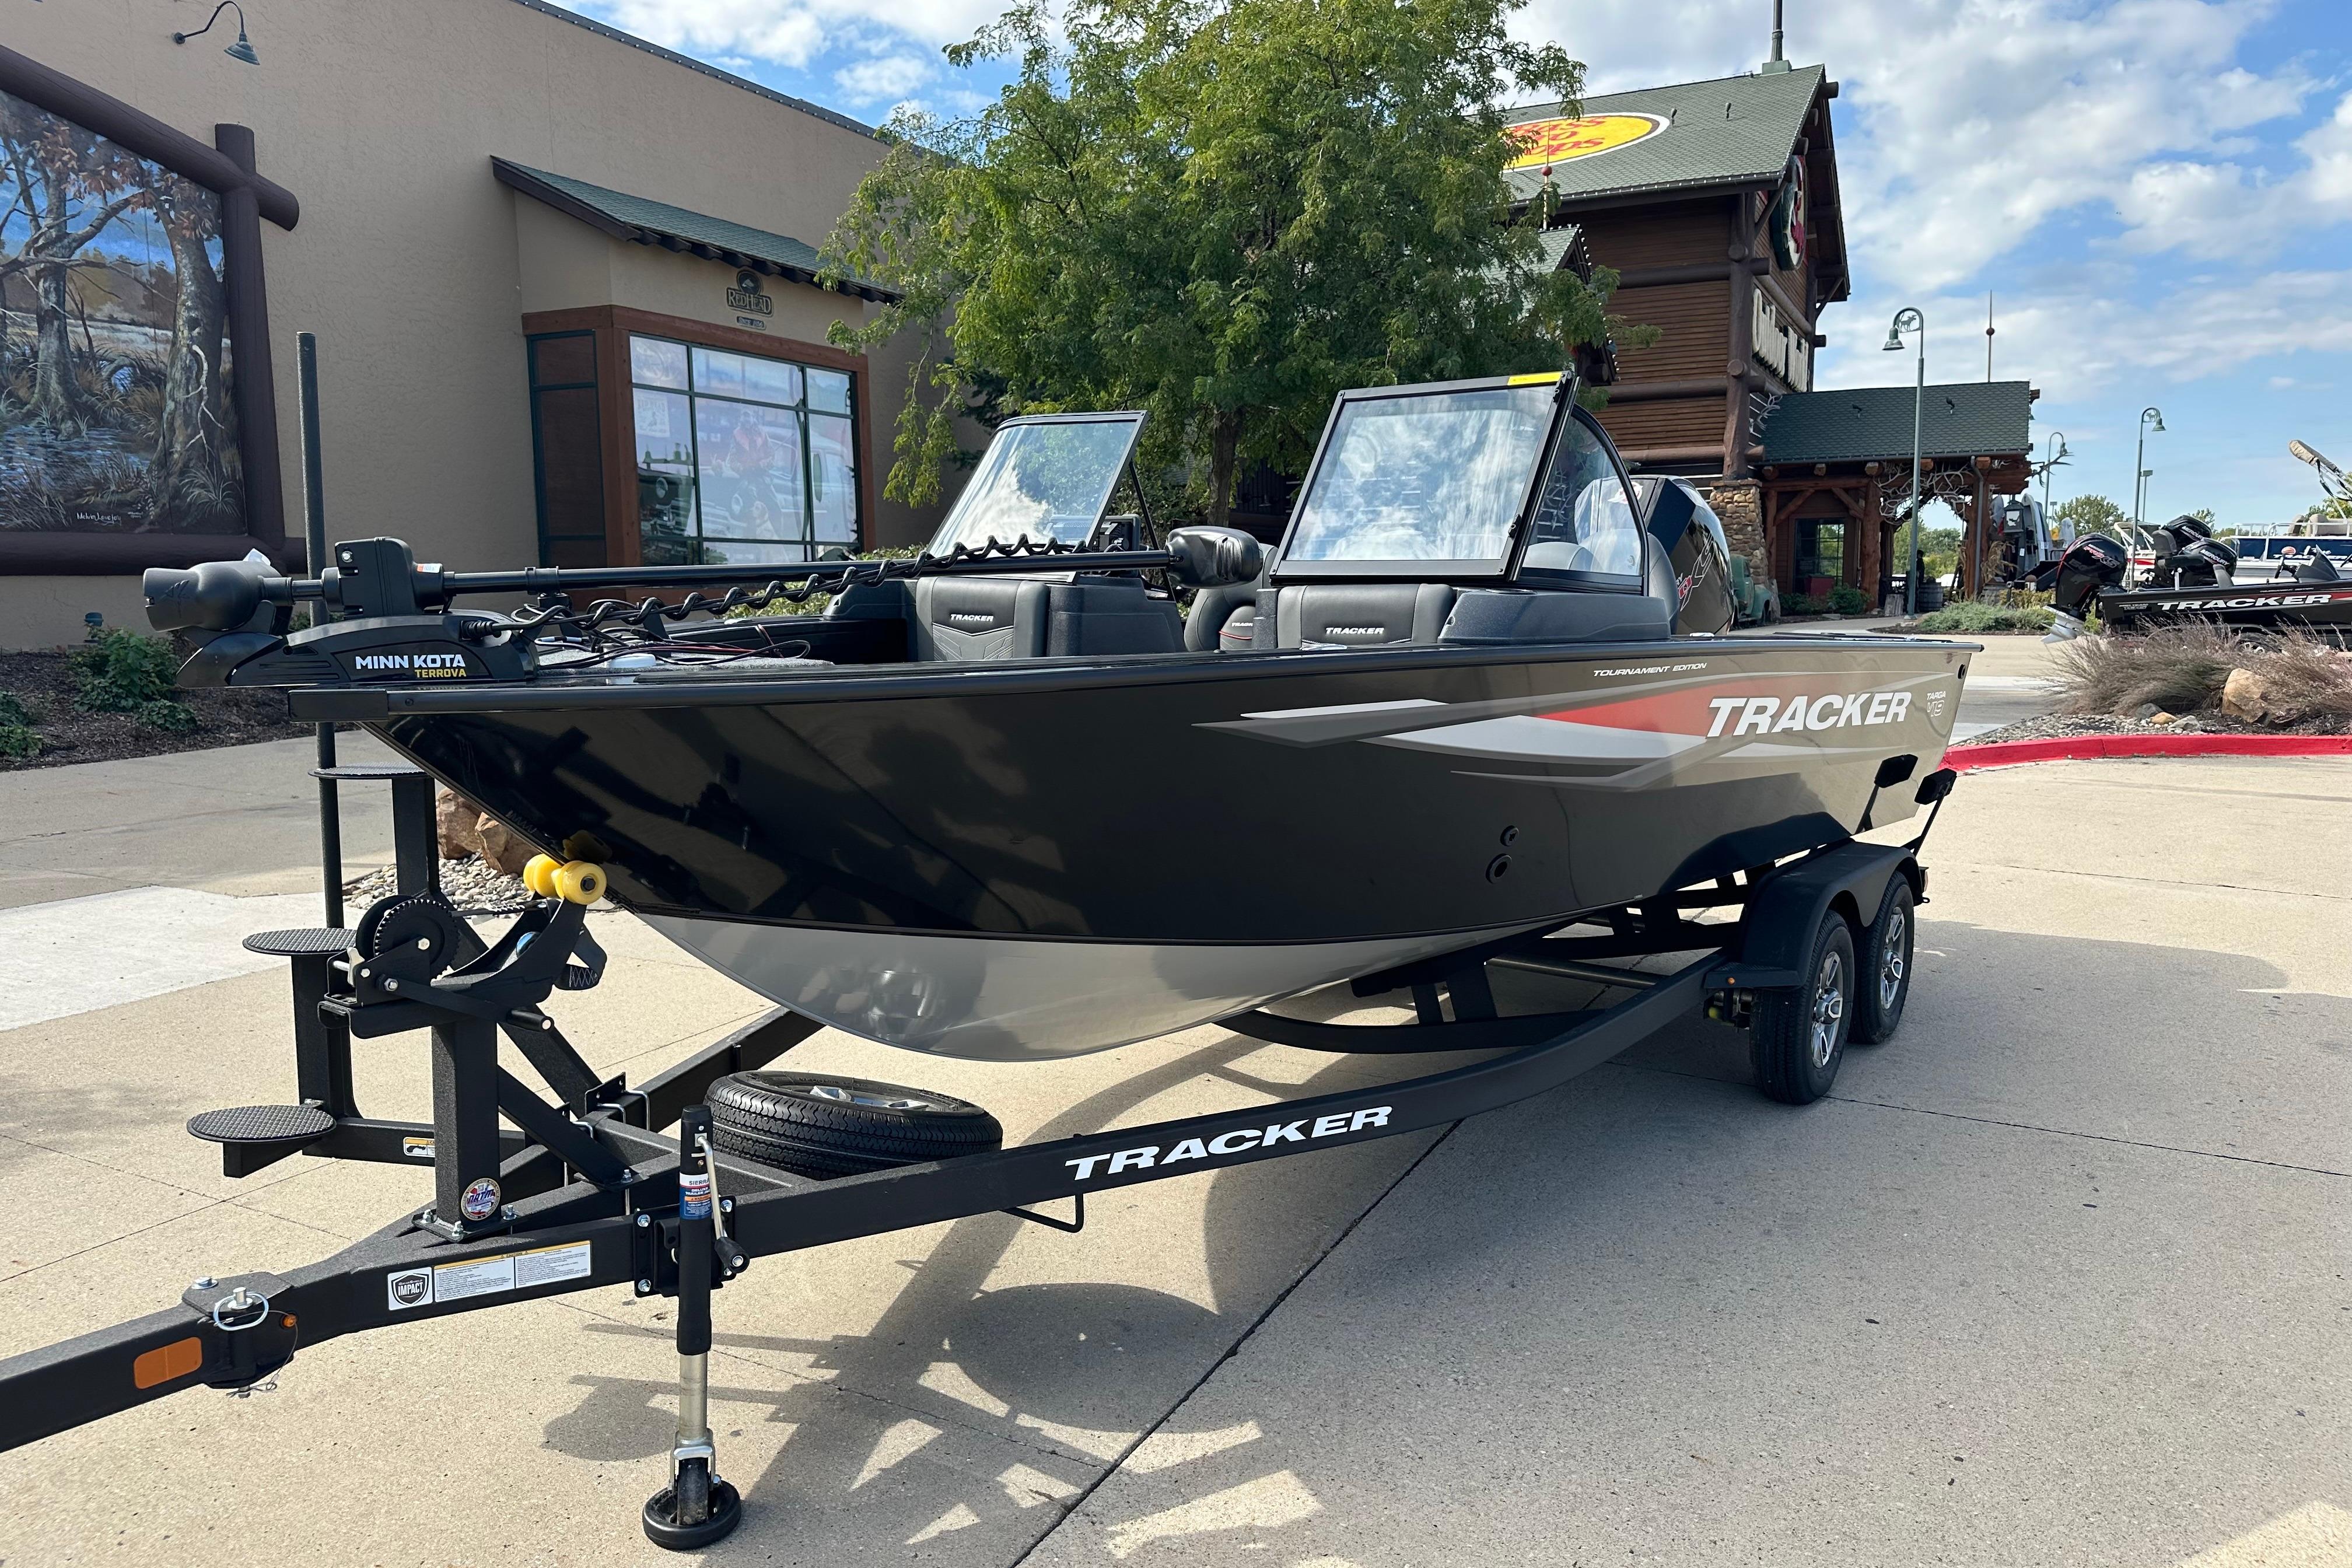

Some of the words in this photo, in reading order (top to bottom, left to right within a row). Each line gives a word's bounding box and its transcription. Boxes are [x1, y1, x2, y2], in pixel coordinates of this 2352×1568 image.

[2158, 594, 2332, 611] TRACKER
[950, 614, 994, 622] TRACKER
[355, 655, 408, 670] MINN
[413, 654, 466, 668] KOTA
[414, 668, 467, 678] TERROVA
[1593, 666, 1671, 677] TOURNAMENT
[1672, 663, 1707, 671] EDITION
[1927, 691, 1946, 700] TARGA
[1707, 692, 1912, 738] TRACKER
[1065, 1106, 1393, 1181] TRACKER
[398, 1282, 424, 1296] IMPACT
